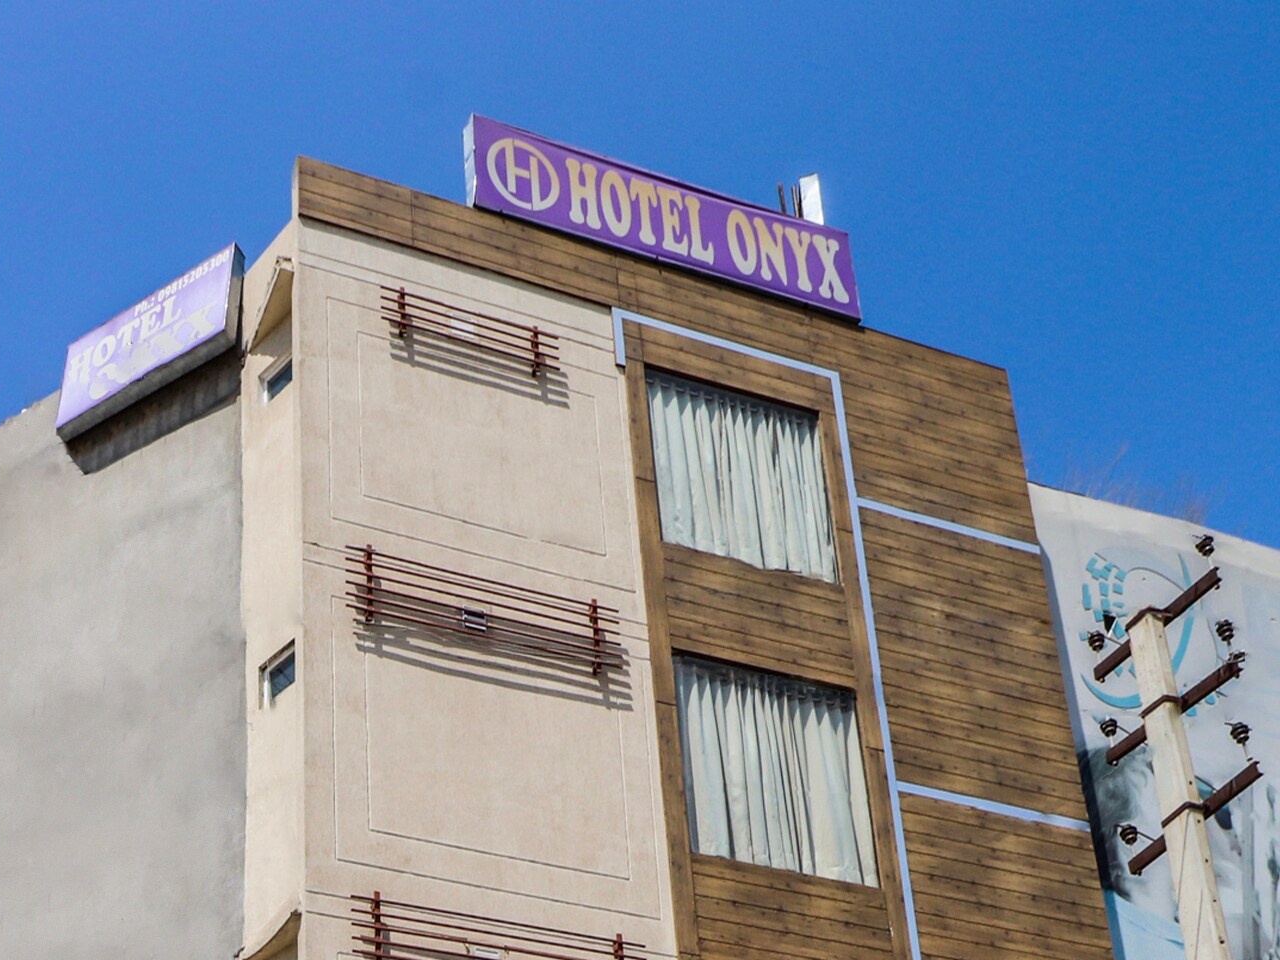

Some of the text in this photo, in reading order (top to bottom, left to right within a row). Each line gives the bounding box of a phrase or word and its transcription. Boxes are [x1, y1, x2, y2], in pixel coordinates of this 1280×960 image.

[565, 157, 715, 265] HOTEL
[727, 208, 850, 304] ONYX
[69, 296, 181, 385] HOTEL
